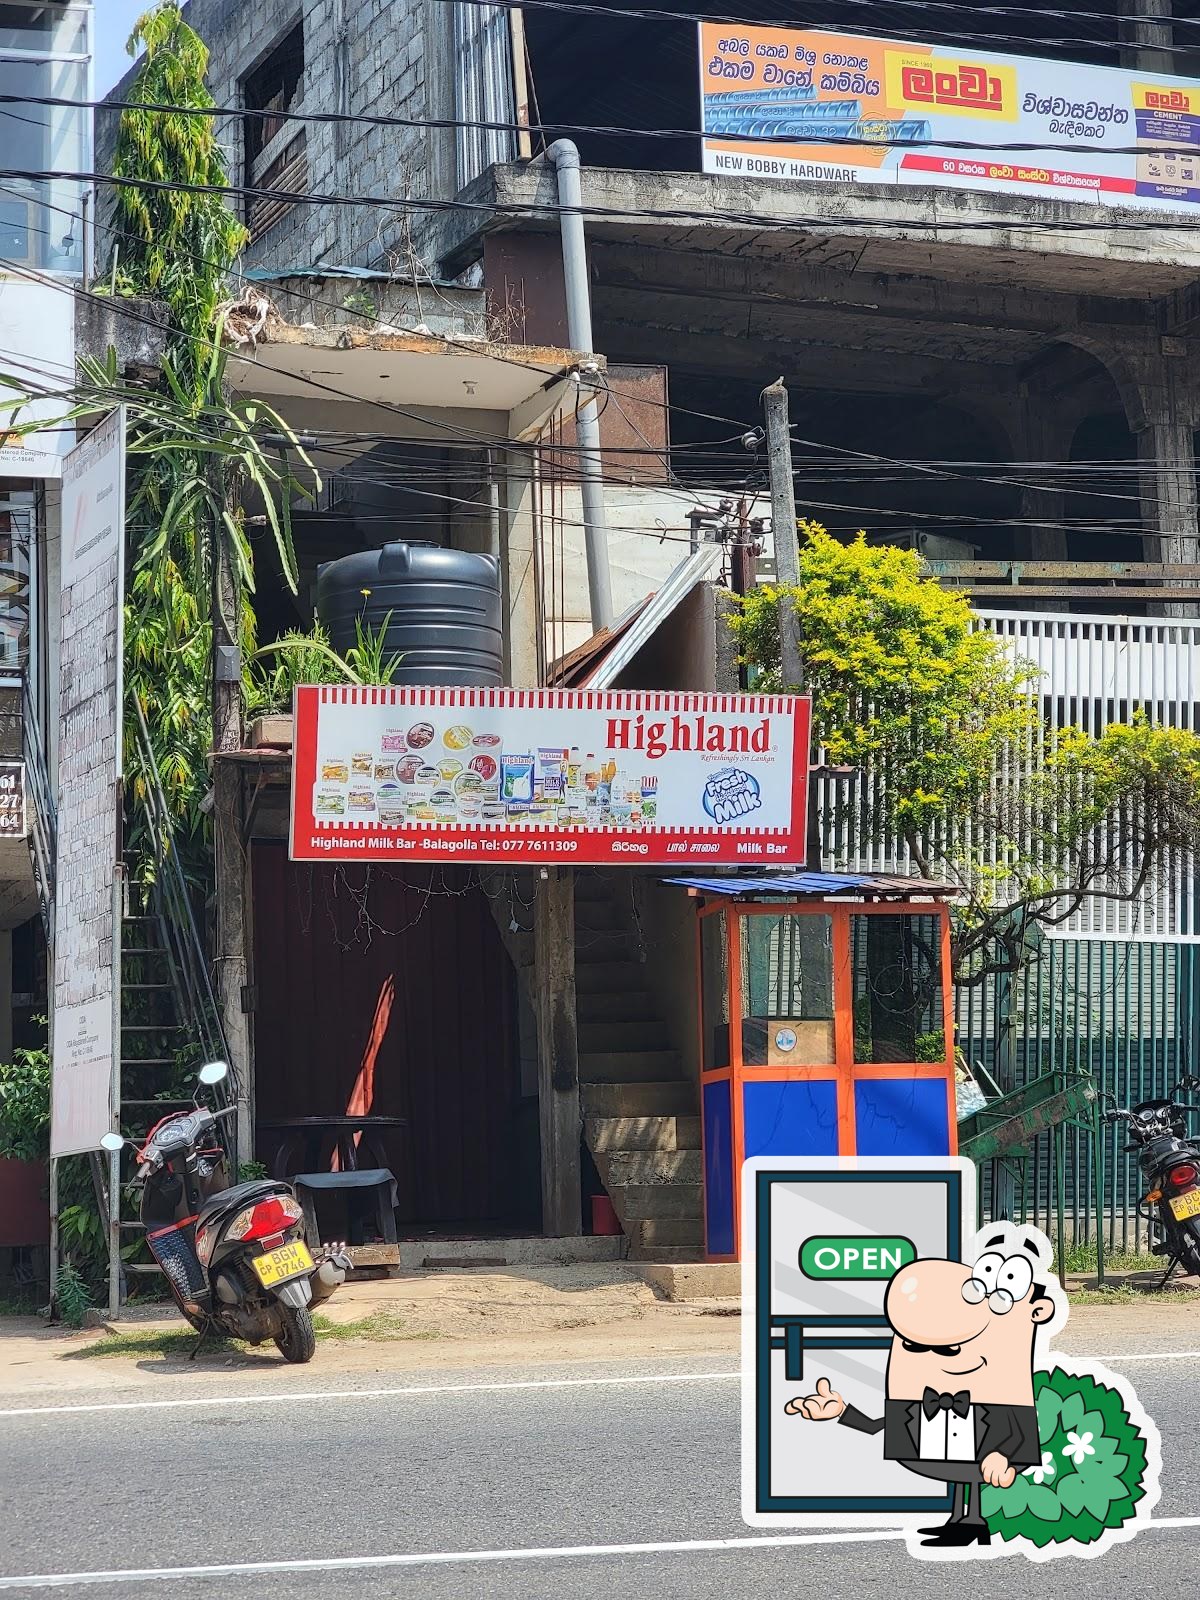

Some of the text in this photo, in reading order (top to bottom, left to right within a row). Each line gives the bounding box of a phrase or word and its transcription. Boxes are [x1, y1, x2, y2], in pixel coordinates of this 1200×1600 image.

[718, 38, 750, 55] අබලි
[756, 43, 788, 59] යකඩ
[763, 63, 814, 88] වානේ
[820, 72, 880, 96] කම්බිය
[902, 65, 1003, 112] ලංවා
[1022, 92, 1129, 124] විශ්වාසවන්ත
[1145, 91, 1190, 112] ලංවා
[1154, 111, 1182, 120] CEMENT
[716, 155, 858, 182] NEW BOBBY HARDWARE
[942, 160, 956, 172] 60
[989, 166, 1014, 179] ලංවා
[604, 714, 771, 759] Highland
[700, 754, 740, 763] Refreshingly
[750, 756, 776, 764] Lankan
[706, 768, 748, 798] Fresh
[714, 790, 762, 824] Milk
[0, 813, 20, 828] 64
[311, 837, 578, 852] Highland Milk Bar -Balagolla Tel: 077 7611309
[666, 840, 688, 853] பால்
[737, 843, 788, 854] Milk Bar
[271, 1246, 298, 1264] BGW
[259, 1258, 306, 1278] CP 0746
